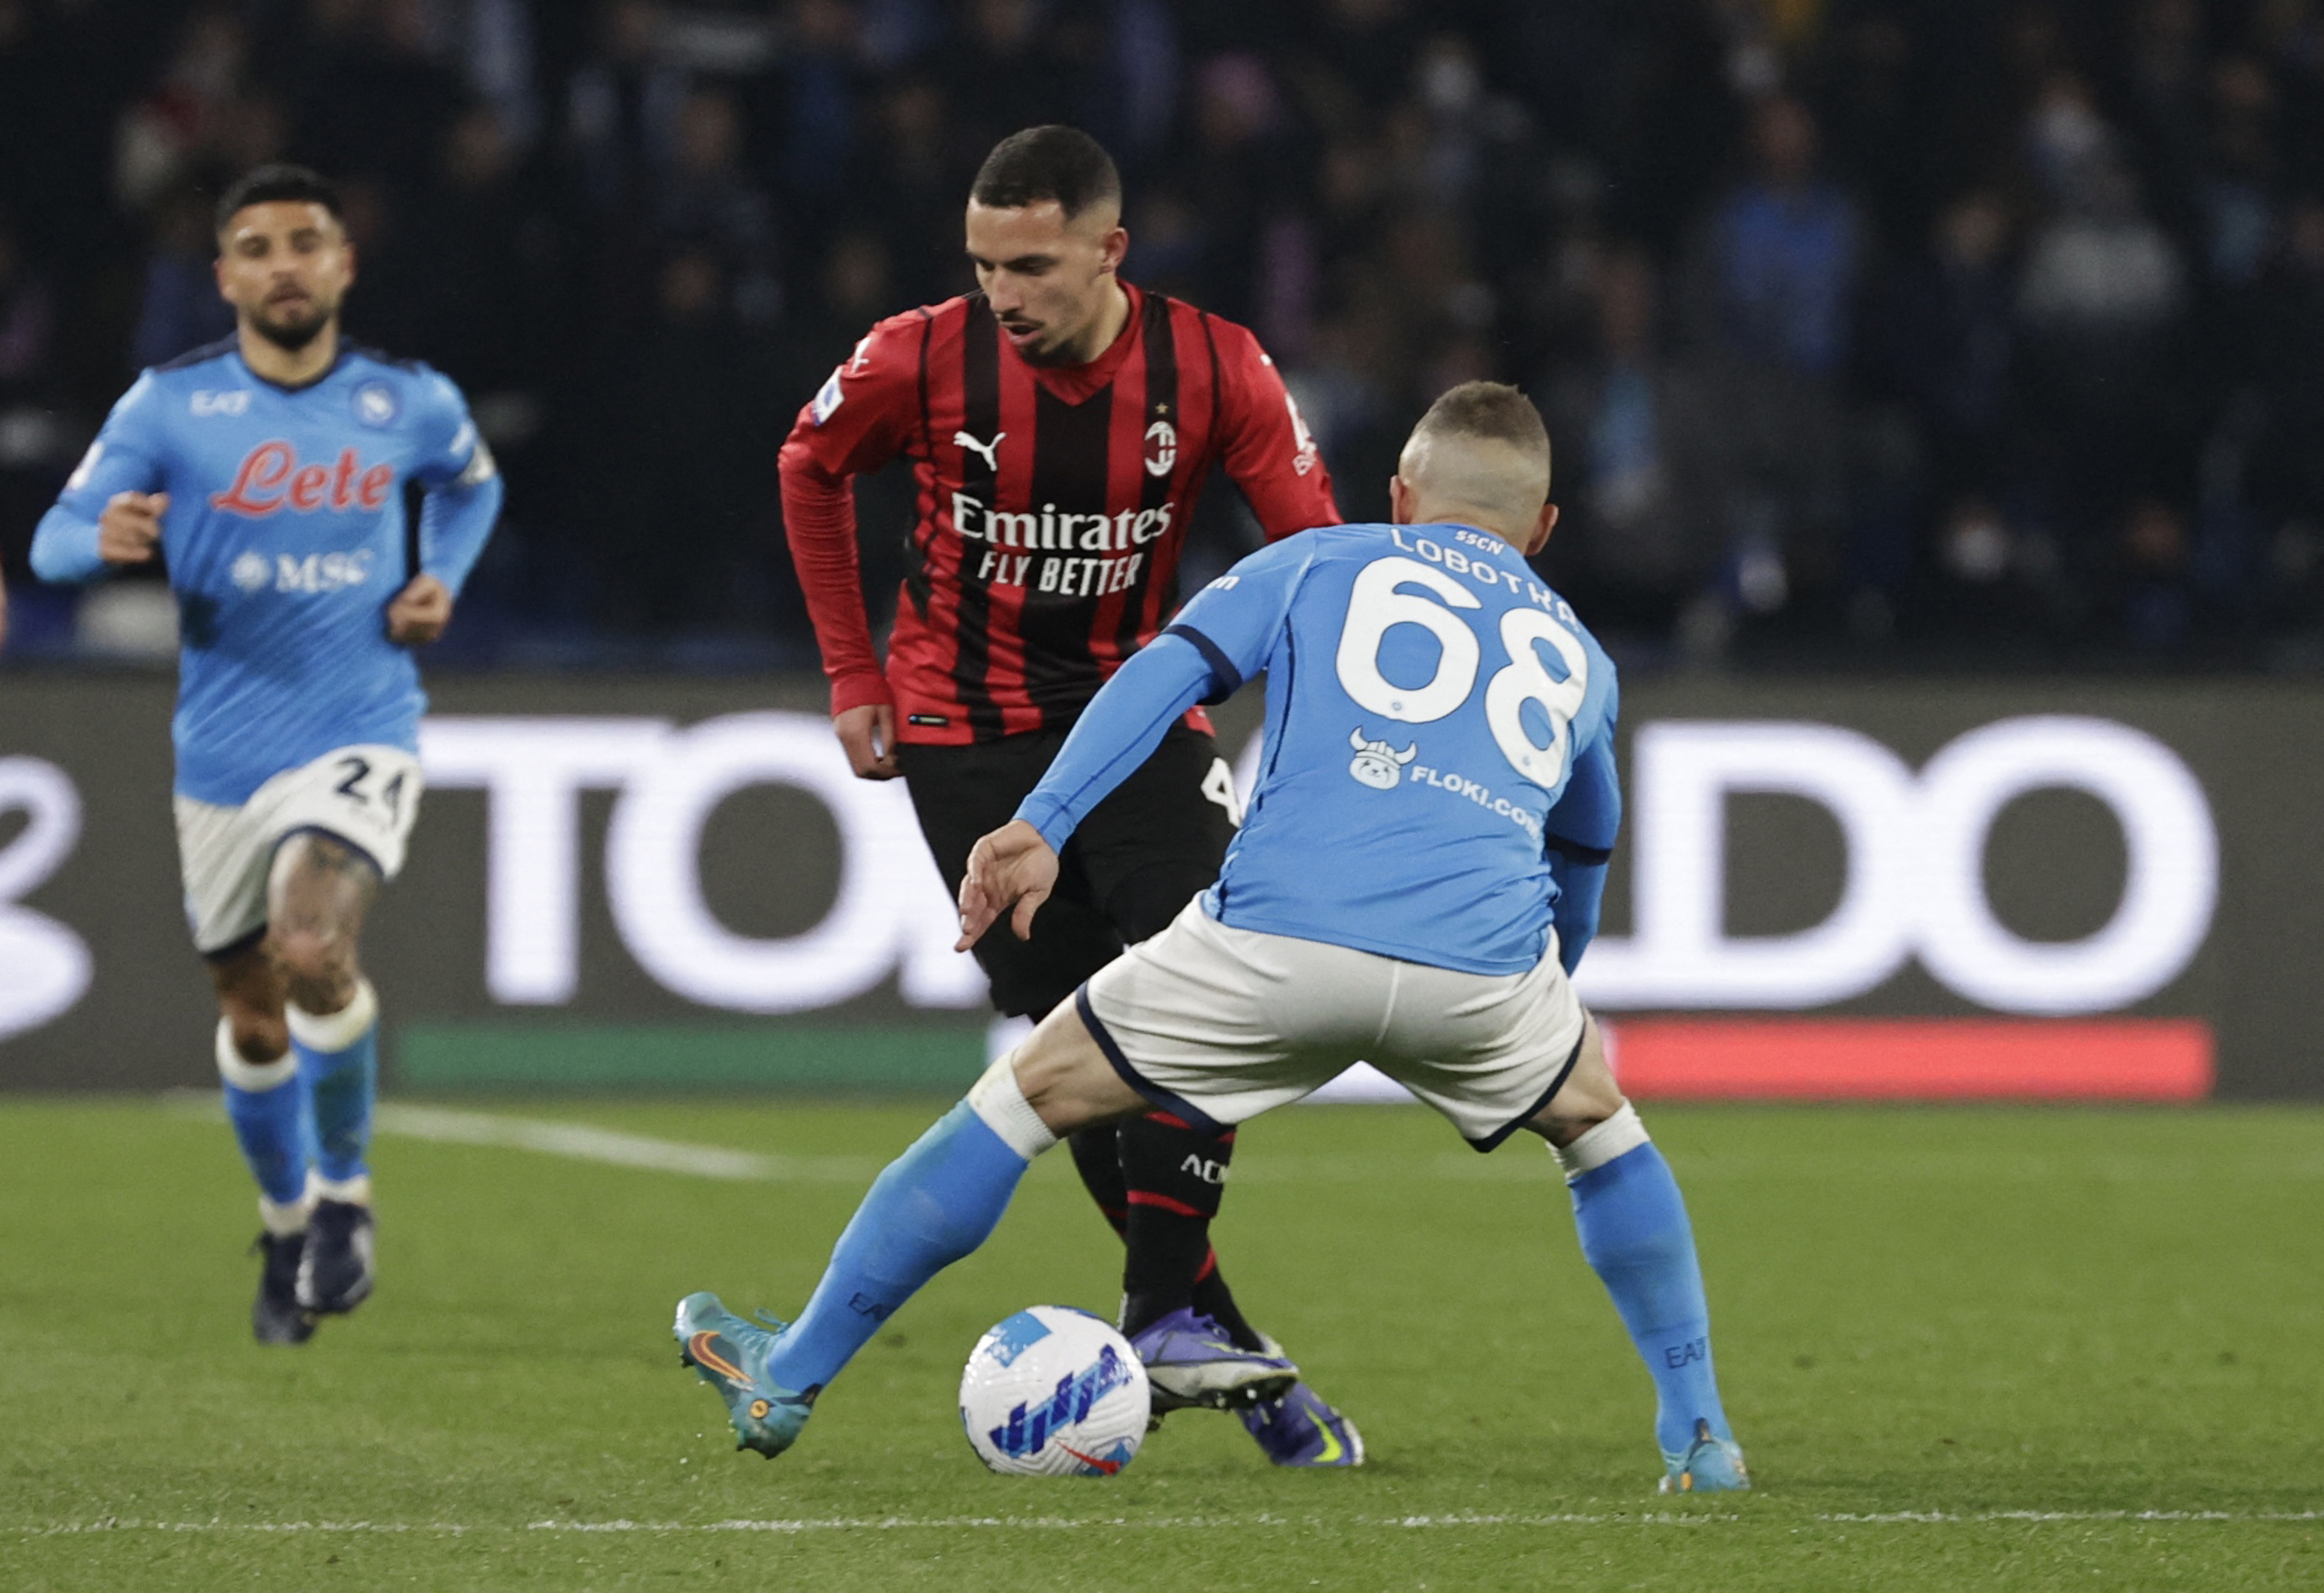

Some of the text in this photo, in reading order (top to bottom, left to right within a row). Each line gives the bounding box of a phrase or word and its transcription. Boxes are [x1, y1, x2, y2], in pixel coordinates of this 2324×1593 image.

[209, 439, 393, 519] Lete
[952, 492, 1175, 552] Emirates
[1454, 530, 1504, 556] SSCN
[276, 550, 372, 592] MSC
[977, 551, 1144, 597] FLY BETTER
[1391, 527, 1581, 633] LOBOTKA
[1336, 556, 1588, 789] 68
[1200, 756, 1242, 829] 4
[1664, 1336, 1708, 1369] EA7
